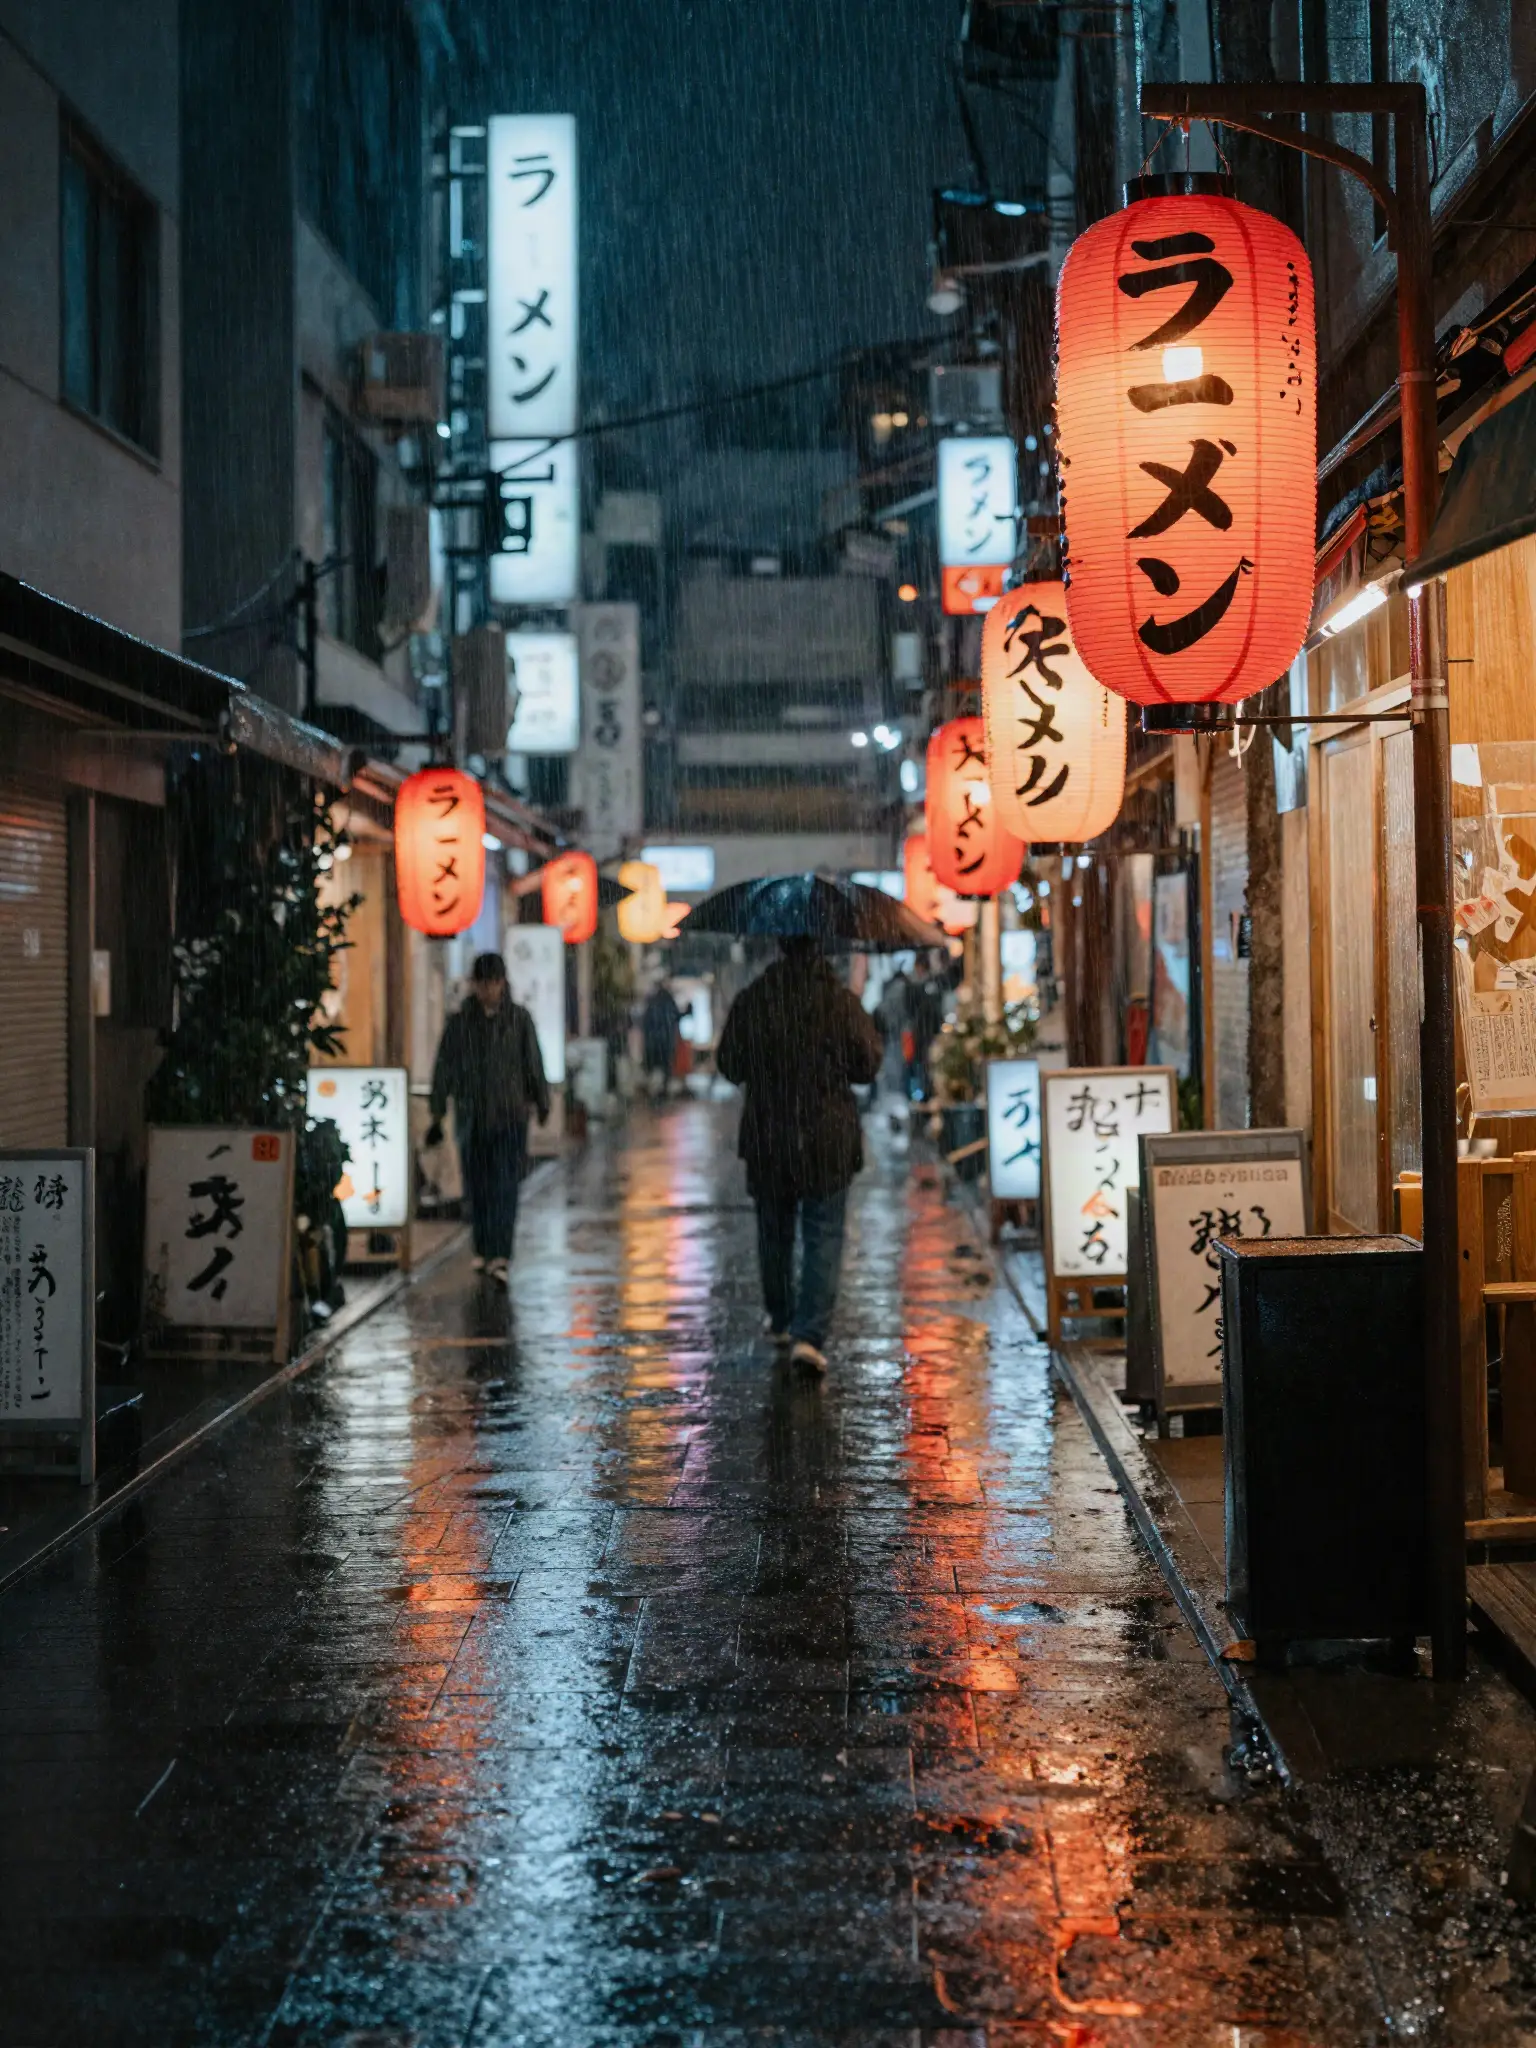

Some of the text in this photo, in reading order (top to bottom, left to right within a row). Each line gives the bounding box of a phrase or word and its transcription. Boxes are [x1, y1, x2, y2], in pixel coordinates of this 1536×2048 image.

[1117, 231, 1254, 655] ラーメン
[428, 785, 460, 917] ラーメン
